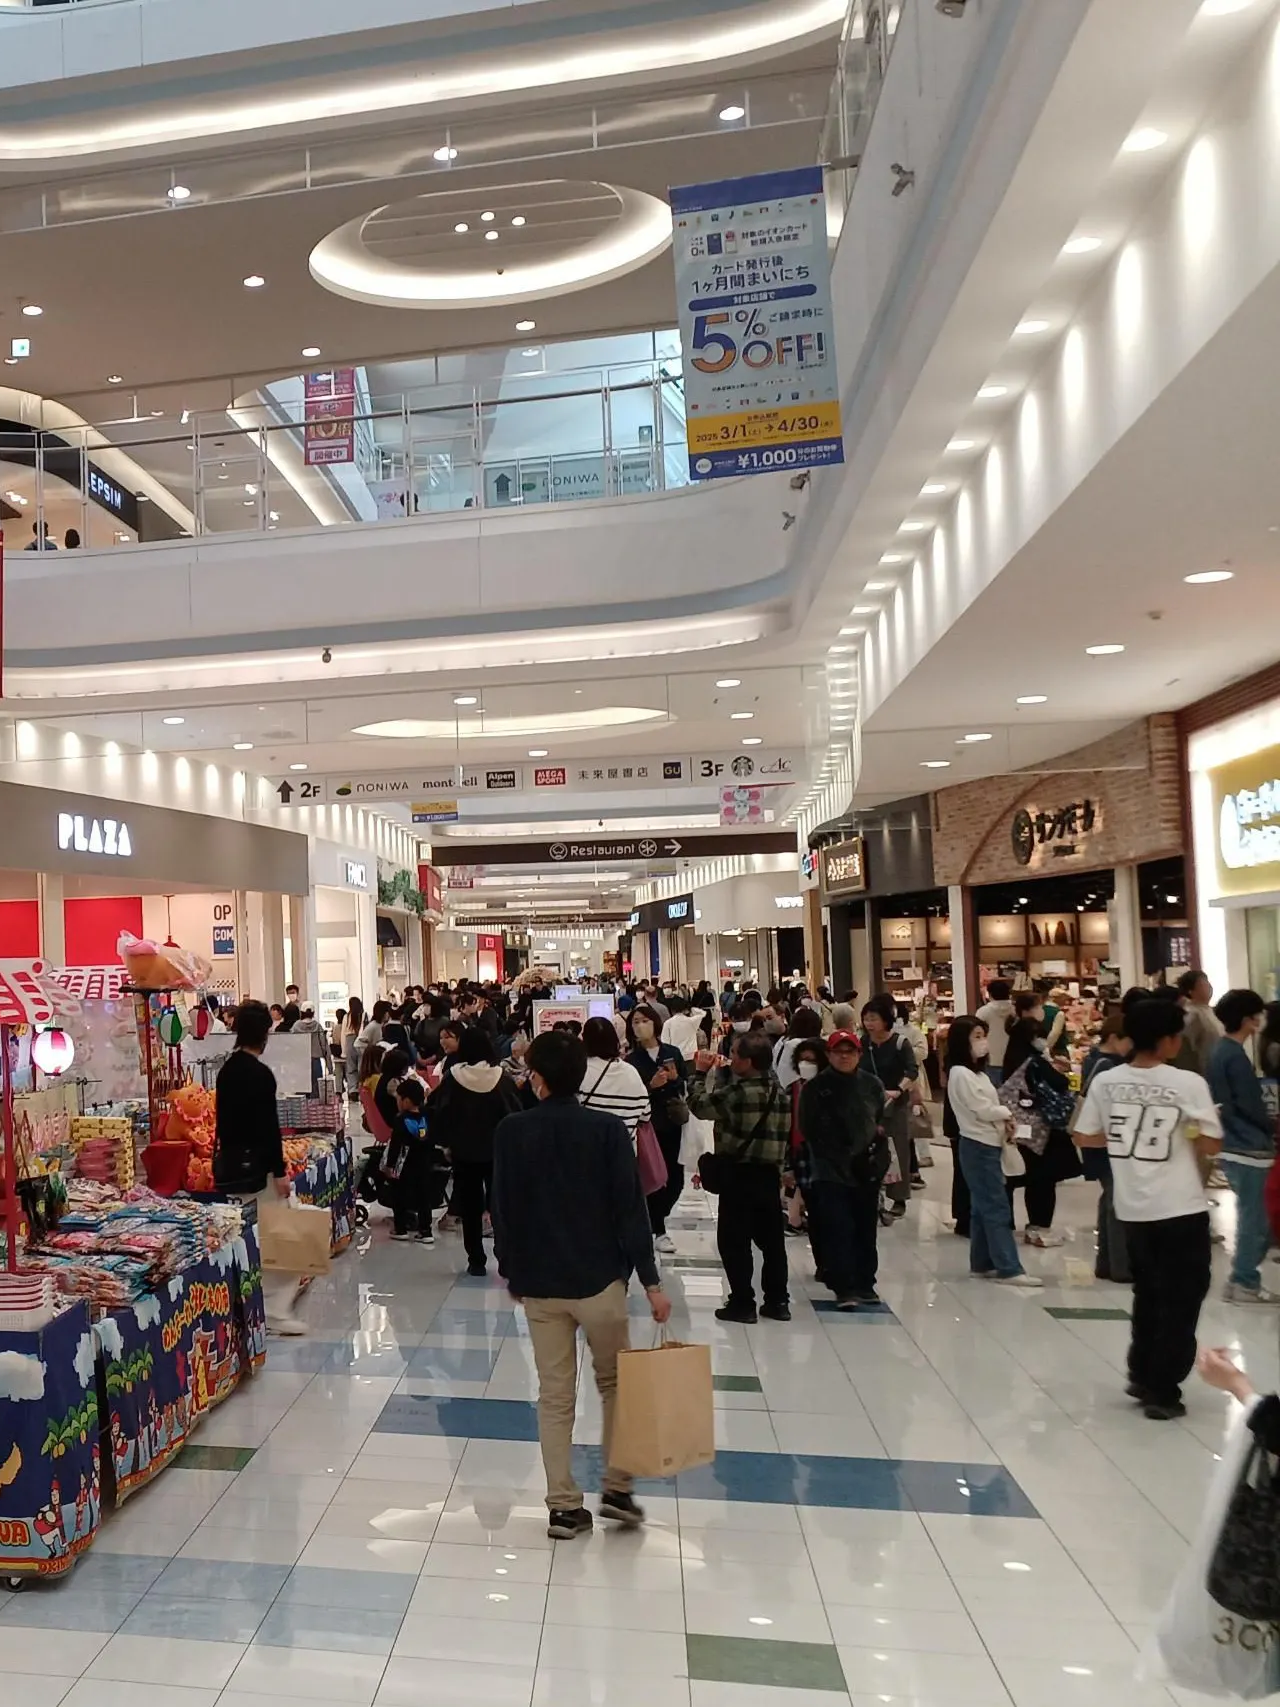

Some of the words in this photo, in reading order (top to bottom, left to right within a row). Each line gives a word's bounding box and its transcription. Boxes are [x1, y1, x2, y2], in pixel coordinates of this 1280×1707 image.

[711, 255, 784, 275] カード発行後
[741, 332, 825, 370] OFF!
[696, 433, 719, 443] 2025
[737, 448, 797, 470] ¥1,000
[537, 769, 564, 779] MEGA
[664, 764, 681, 776] GU
[700, 760, 725, 777] 3F
[487, 773, 515, 782] Alpen
[536, 776, 564, 785] SPORTS
[300, 782, 321, 799] 2F
[58, 812, 132, 857] PLAZA
[571, 842, 635, 857] Restaurant
[1105, 1101, 1183, 1162] 38
